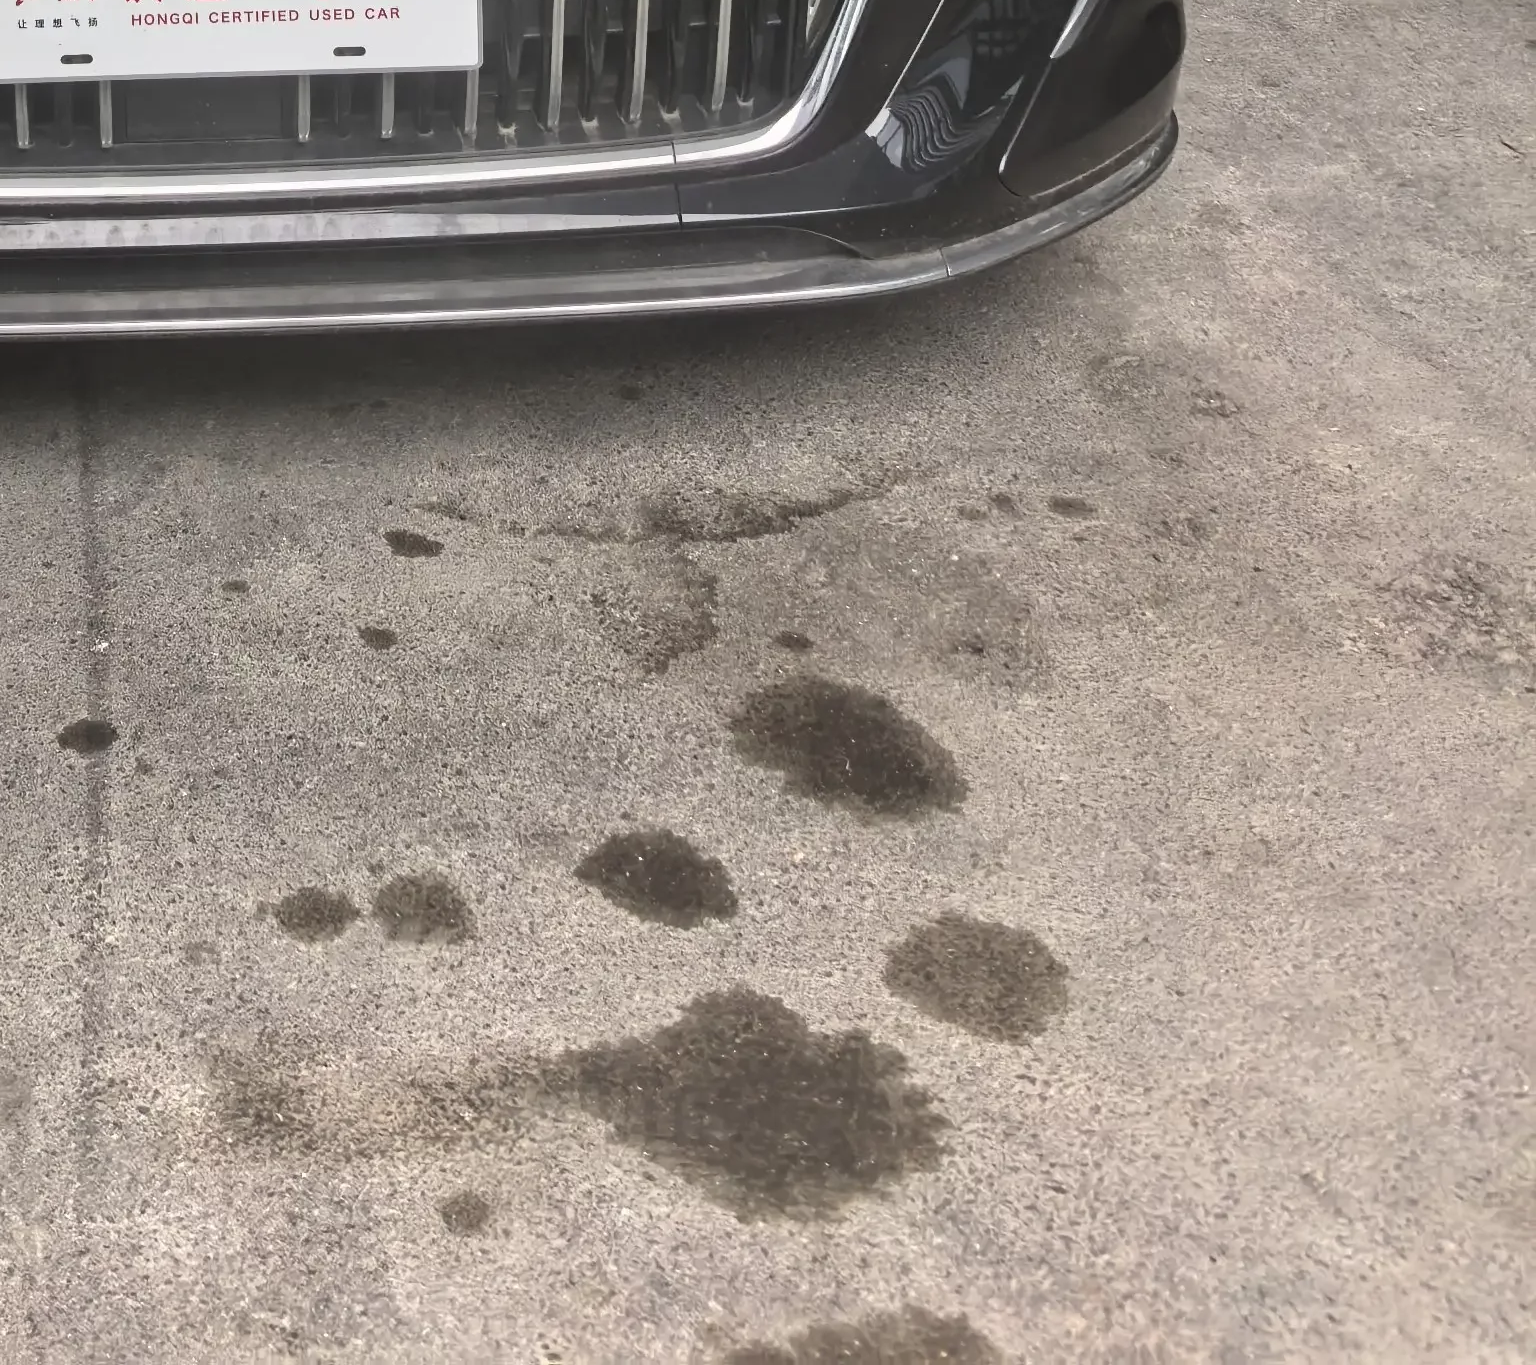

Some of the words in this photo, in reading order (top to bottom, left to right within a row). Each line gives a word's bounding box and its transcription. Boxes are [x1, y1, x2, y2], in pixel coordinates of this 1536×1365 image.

[17, 16, 99, 29] 让理想飞扬
[131, 12, 199, 26] HONGQI
[209, 10, 299, 24] CERTIFIED
[309, 8, 355, 21] USED
[364, 7, 400, 20] CAR
